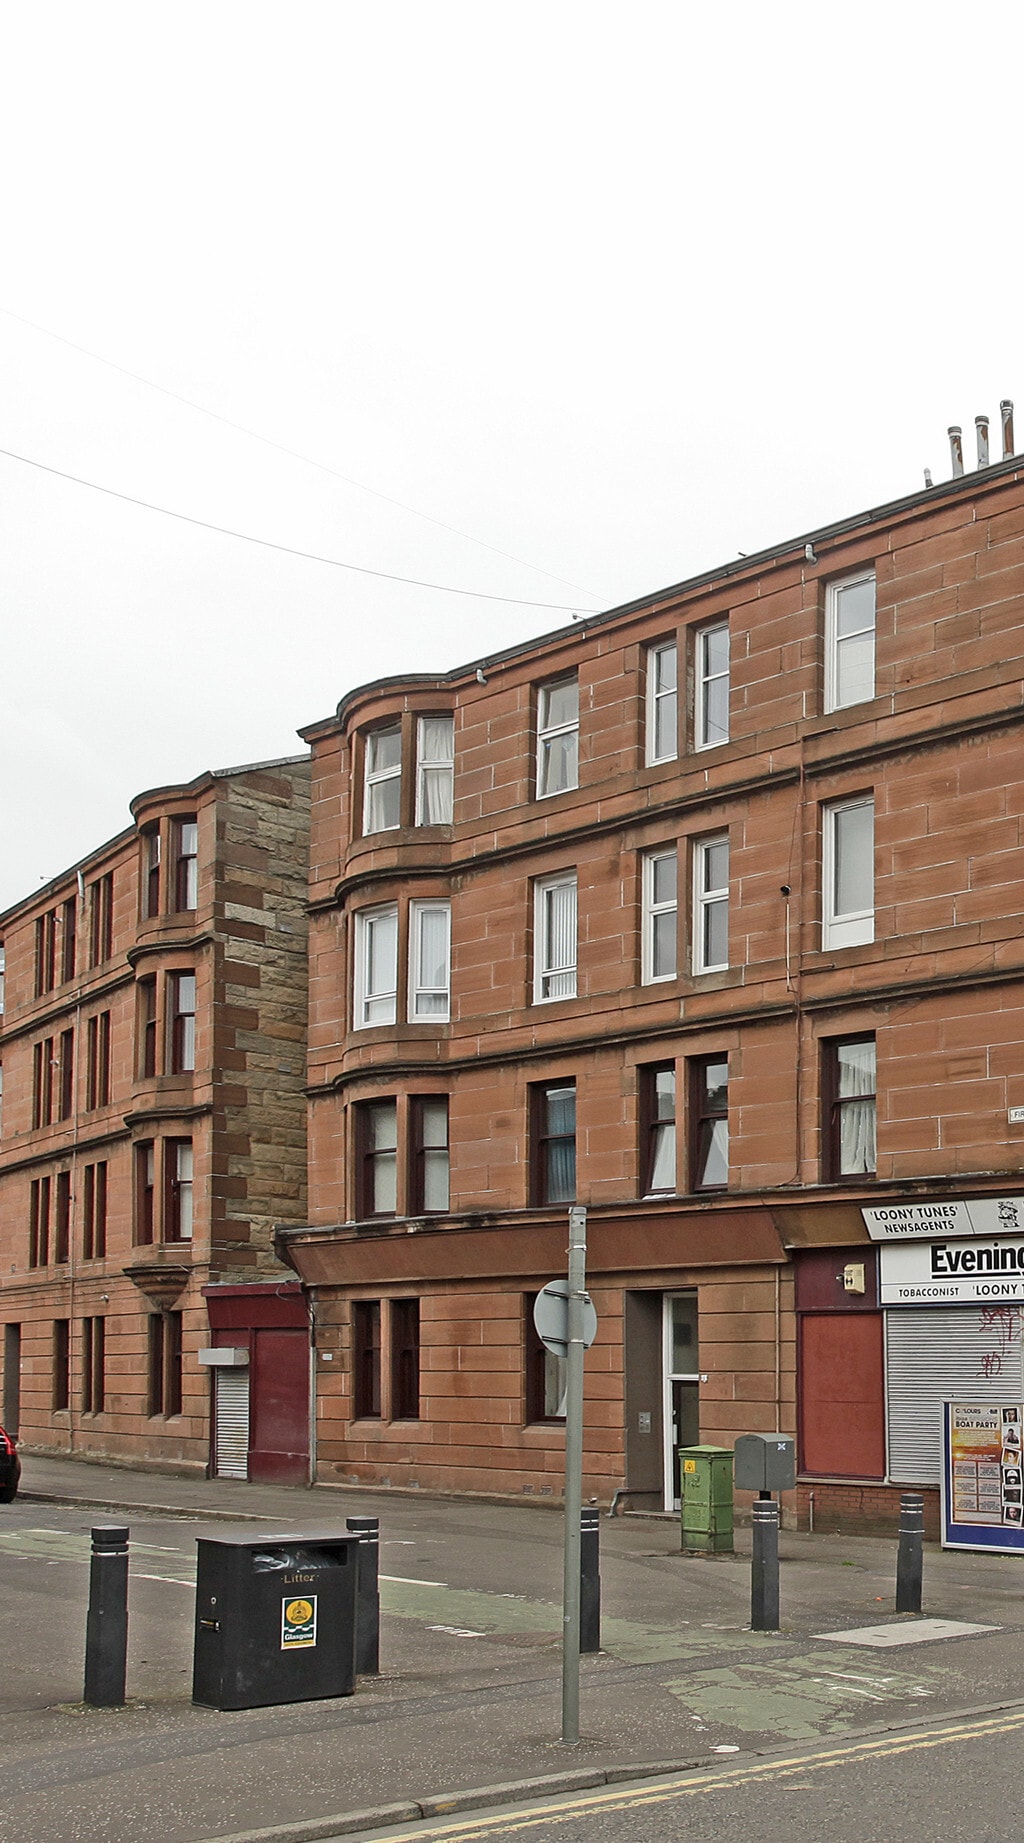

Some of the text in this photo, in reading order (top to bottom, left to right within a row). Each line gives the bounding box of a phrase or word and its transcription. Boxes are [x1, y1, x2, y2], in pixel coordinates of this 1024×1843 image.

[870, 1206, 958, 1222] 'LOONY TUNES'
[884, 1220, 954, 1233] NEWSAGENTS
[898, 1287, 959, 1297] TOBACCONIST
[972, 1284, 1018, 1295] 'LOONY
[284, 1574, 315, 1584] Litter
[284, 1633, 313, 1641] Glasgow
